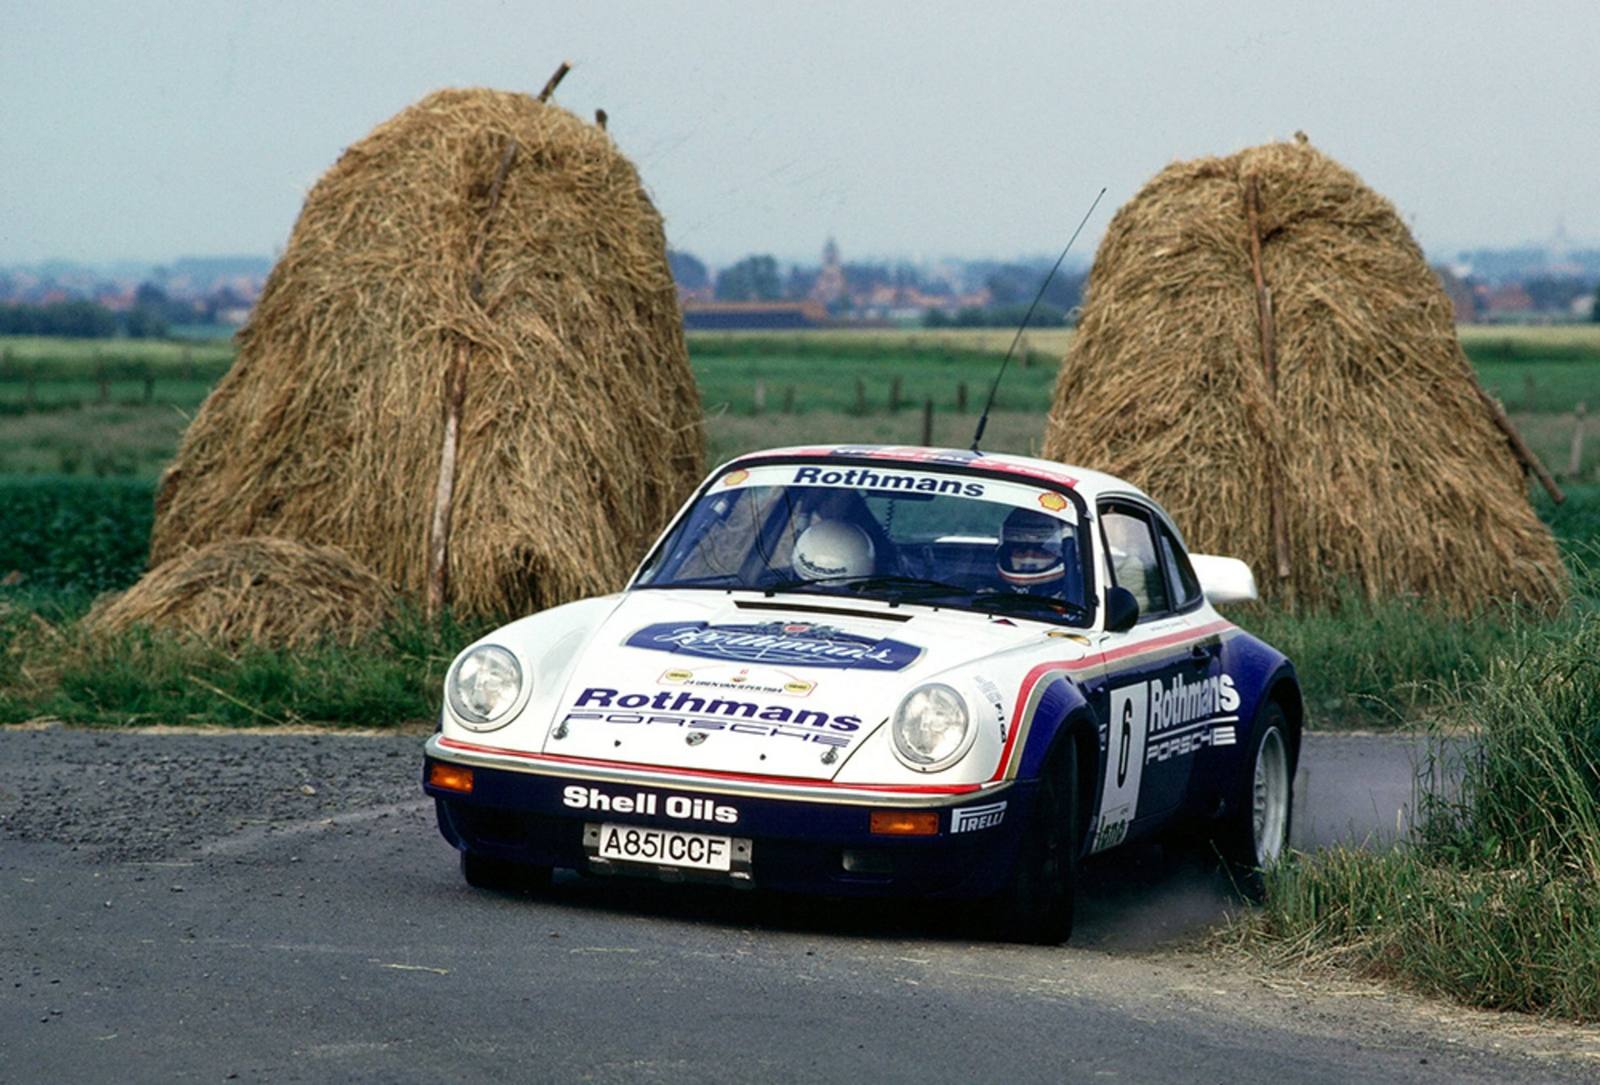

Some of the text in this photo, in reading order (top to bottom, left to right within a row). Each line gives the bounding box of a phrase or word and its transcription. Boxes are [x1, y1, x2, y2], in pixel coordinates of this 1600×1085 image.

[793, 466, 985, 498] Rothmans
[573, 688, 863, 732] Rothmans
[1149, 673, 1241, 732] Rothmans
[564, 712, 852, 747] PORSCHE
[1117, 697, 1132, 789] 6
[1146, 726, 1237, 765] PORSCHE
[563, 786, 739, 824] Shell Oils
[951, 801, 1008, 833] PIRELLI
